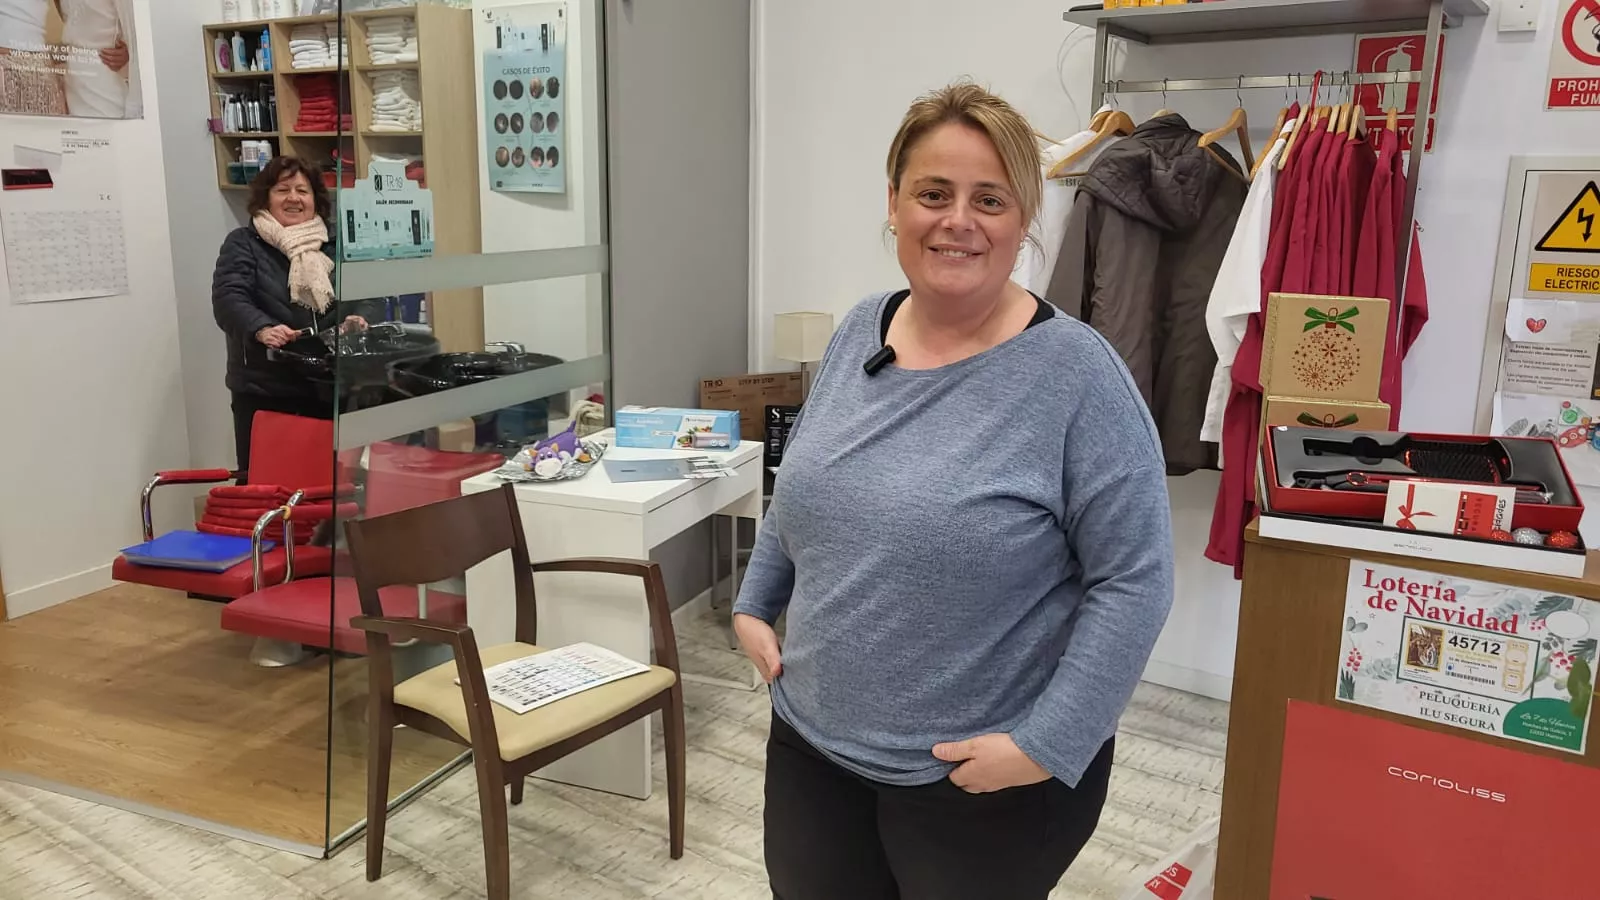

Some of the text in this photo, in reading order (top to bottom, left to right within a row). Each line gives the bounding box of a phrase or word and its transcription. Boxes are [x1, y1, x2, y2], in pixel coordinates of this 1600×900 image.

[60, 44, 71, 53] of
[502, 66, 522, 75] CASOS
[1556, 267, 1600, 279] RIESGO
[1544, 278, 1600, 291] ELECTRIC
[1362, 568, 1458, 603] Lotería
[1367, 590, 1519, 634] de Navidad
[1448, 635, 1501, 656] 45712
[1419, 690, 1501, 717] PELUQUERÍA
[1420, 707, 1497, 731] ILU SEGURA
